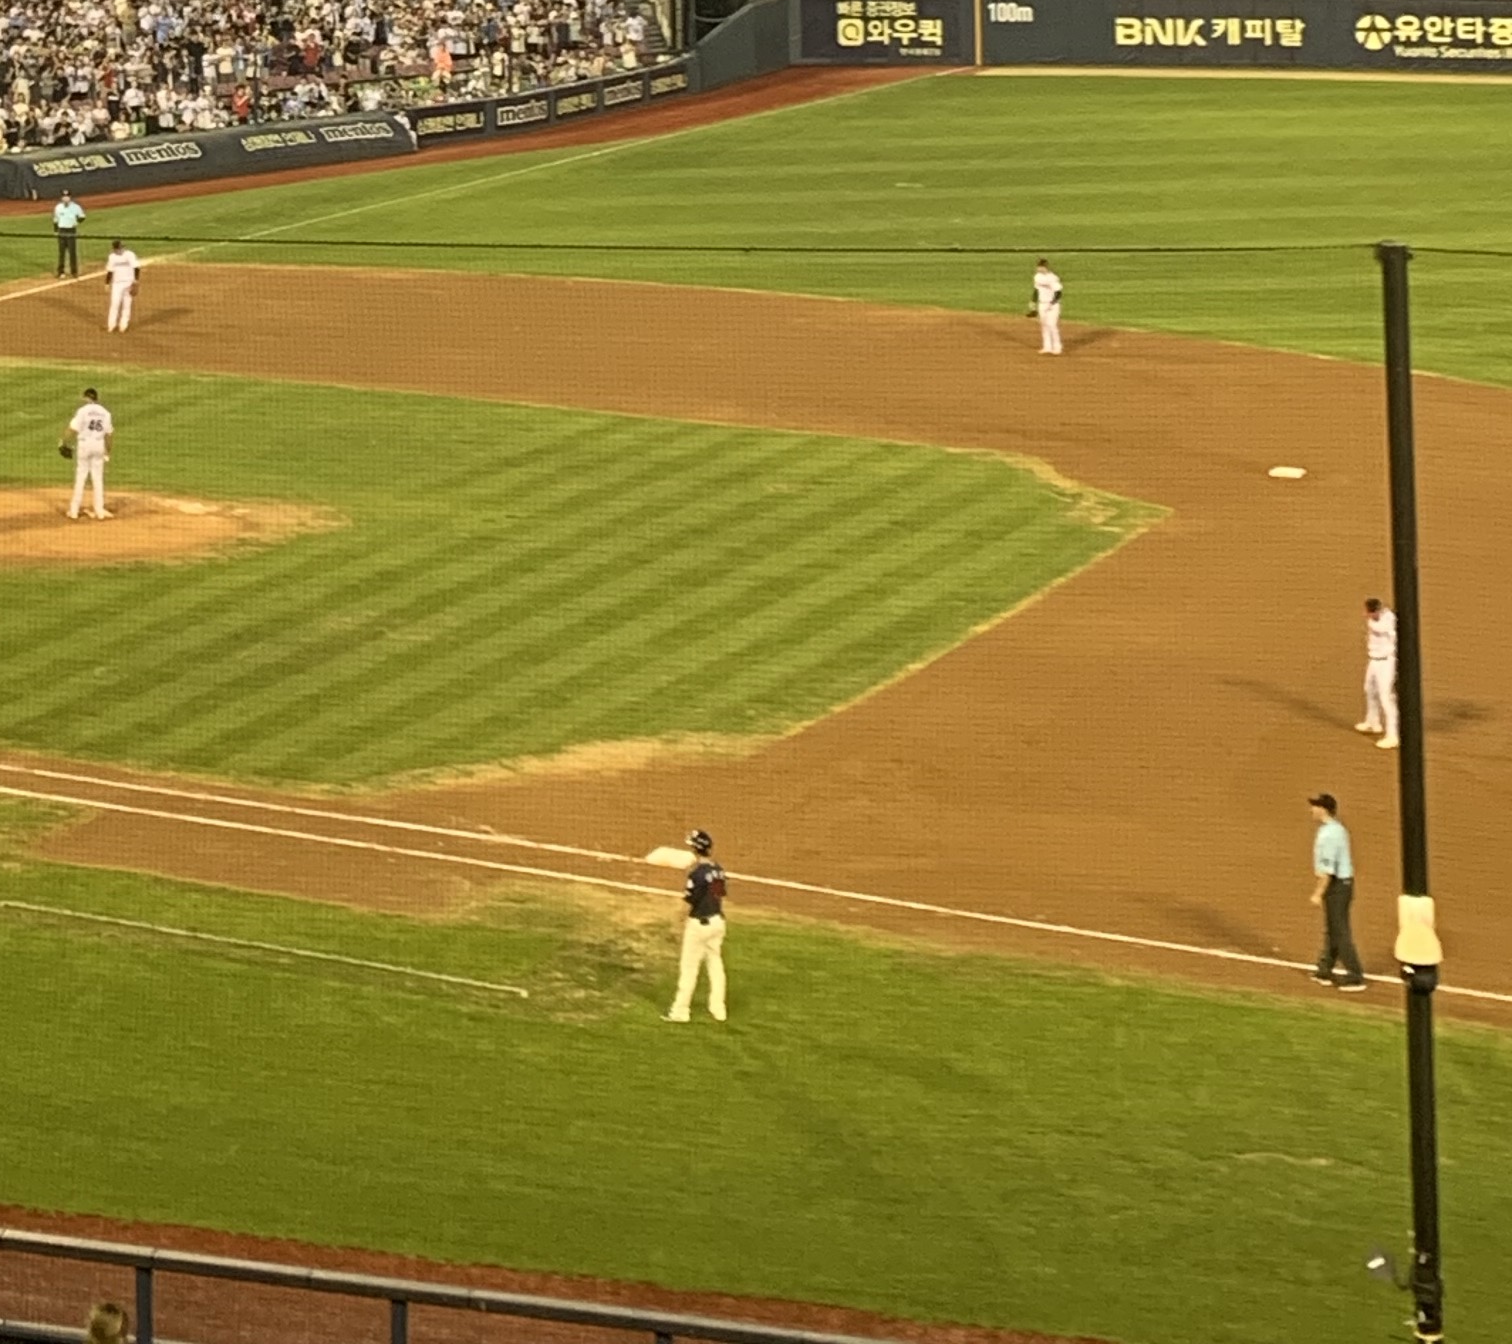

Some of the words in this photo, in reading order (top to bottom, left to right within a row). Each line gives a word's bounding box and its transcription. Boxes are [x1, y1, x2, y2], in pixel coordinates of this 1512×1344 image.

[987, 2, 1033, 22] 100m
[866, 19, 943, 46] 와우퀵
[1115, 17, 1207, 46] BNK
[1211, 17, 1306, 47] 캐피탈
[319, 120, 395, 143] mentos
[120, 141, 203, 166] mentos
